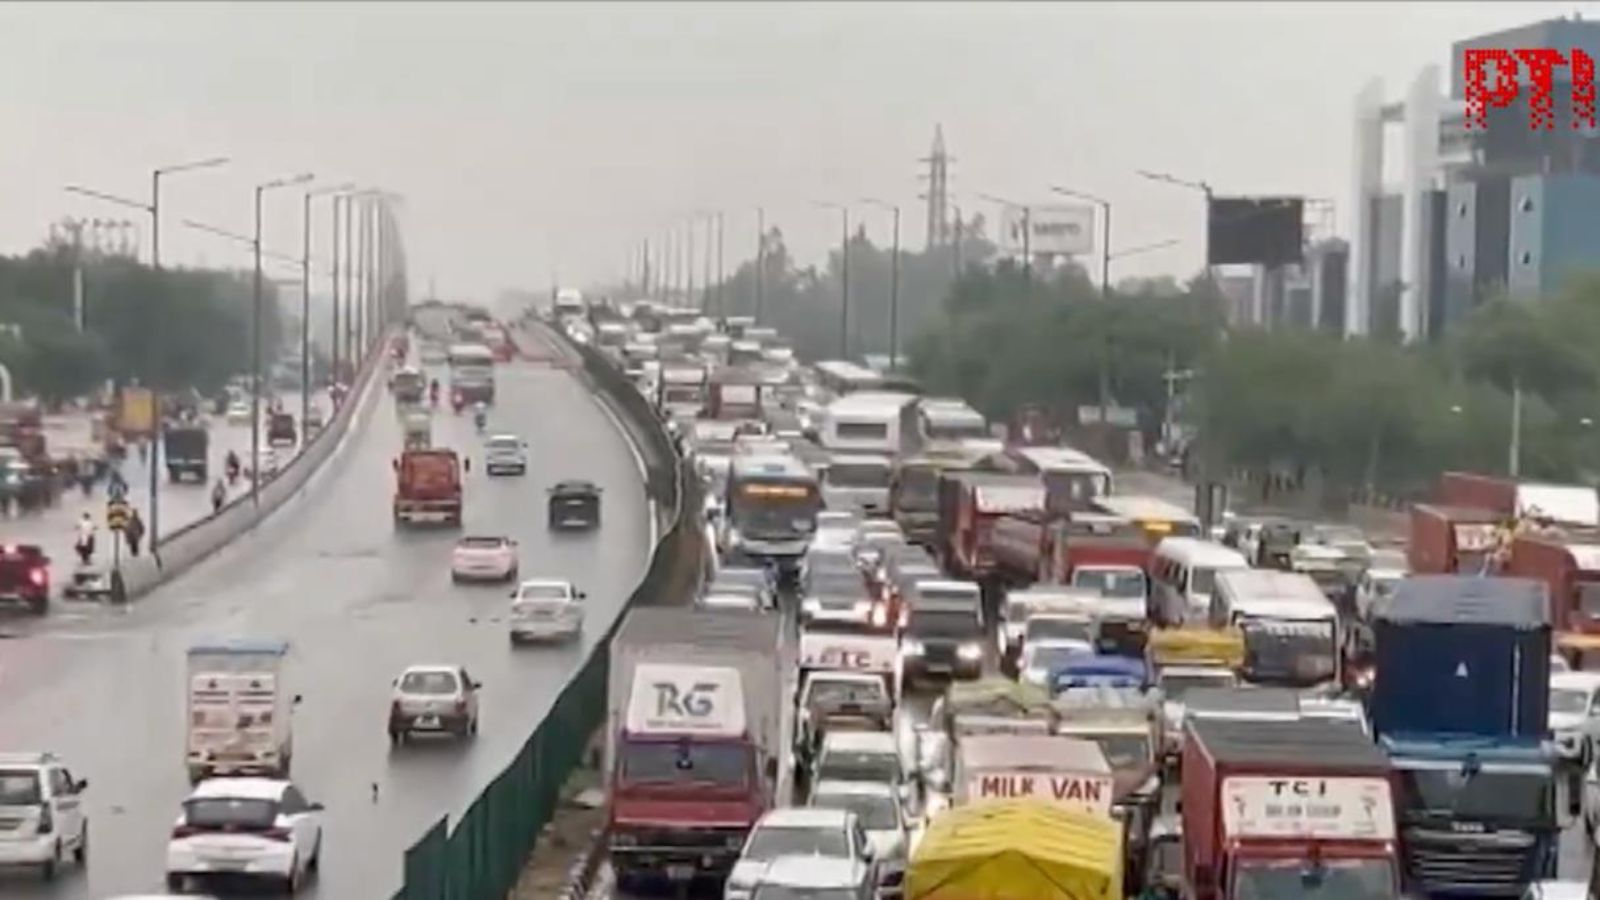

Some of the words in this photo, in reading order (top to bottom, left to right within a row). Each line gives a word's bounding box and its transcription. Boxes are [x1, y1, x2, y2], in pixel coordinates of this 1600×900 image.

[652, 682, 720, 717] RG
[981, 776, 1034, 798] MILK
[1051, 778, 1101, 801] VAN
